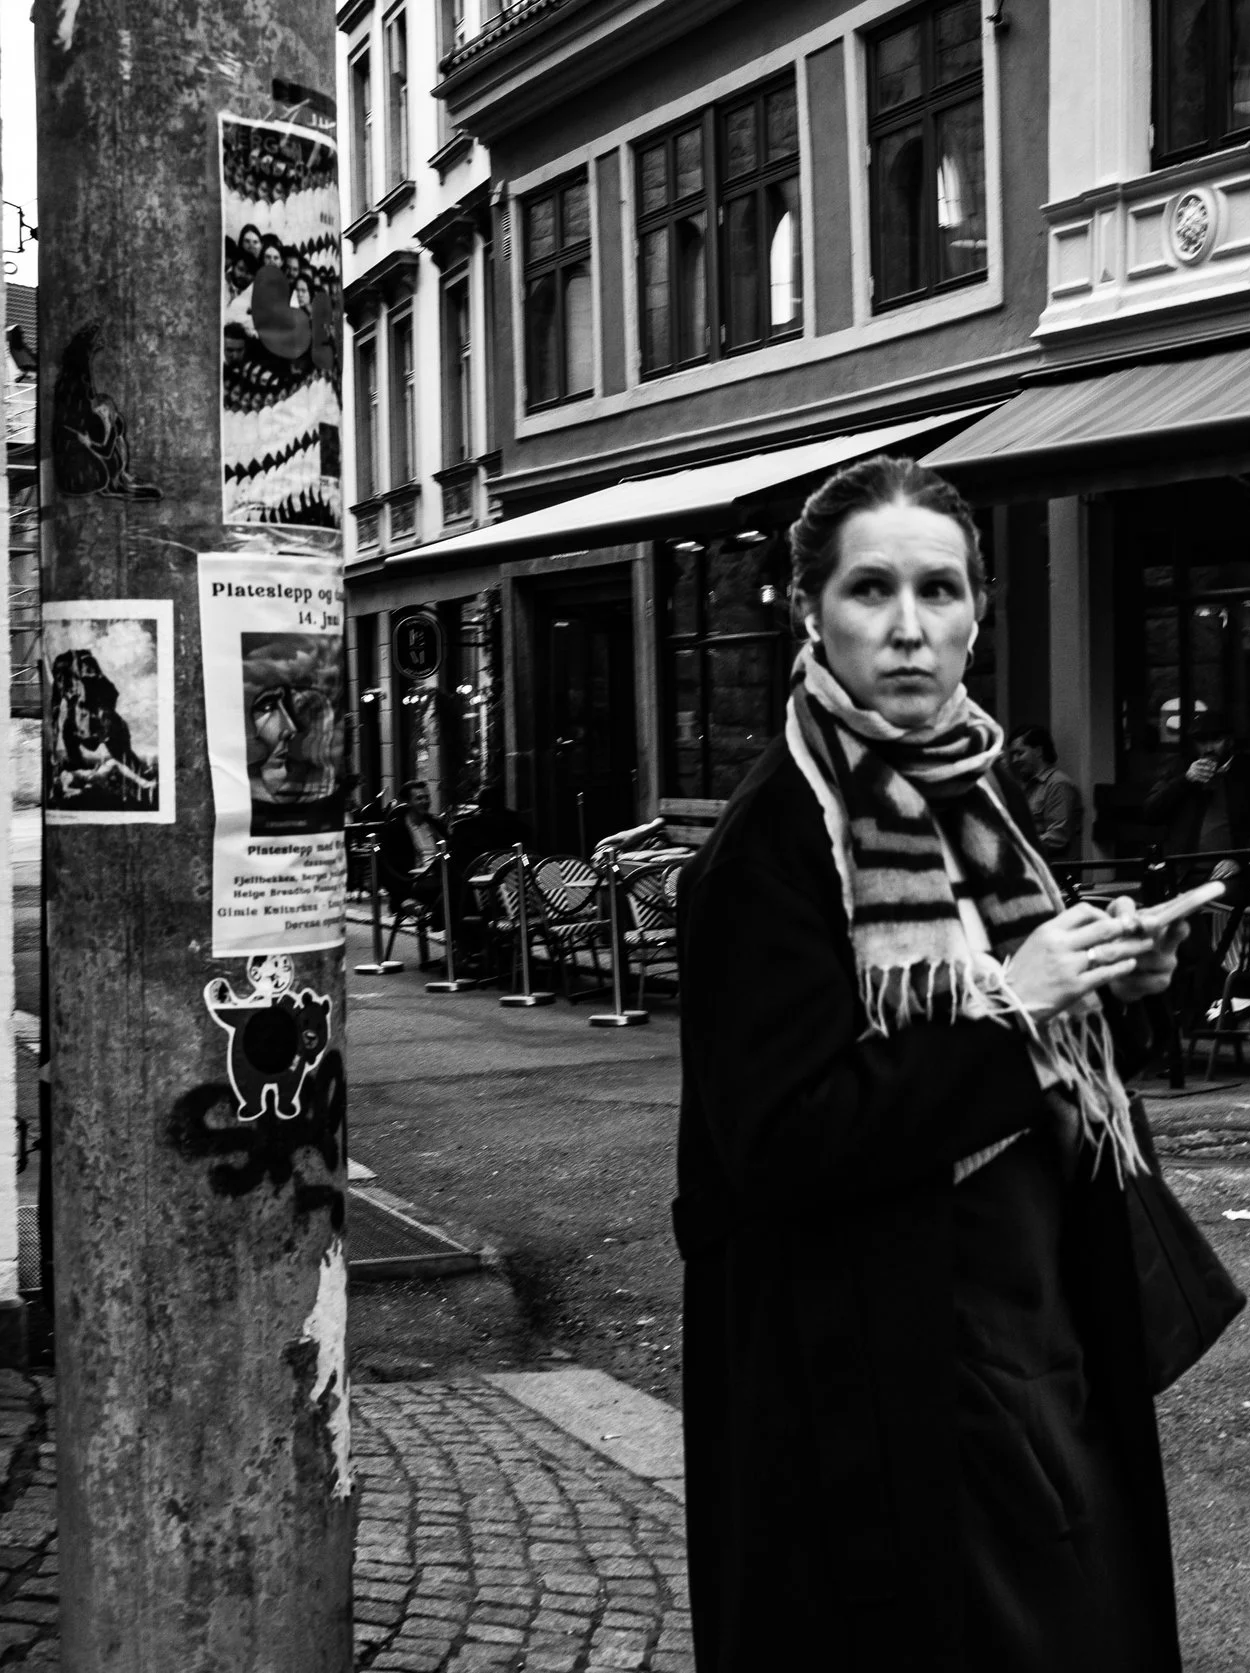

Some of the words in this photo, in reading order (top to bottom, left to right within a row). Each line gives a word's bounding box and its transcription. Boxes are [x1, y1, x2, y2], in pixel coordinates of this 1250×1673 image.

[212, 582, 313, 603] Plateslepp
[318, 589, 332, 605] og
[217, 907, 258, 918] Gimle
